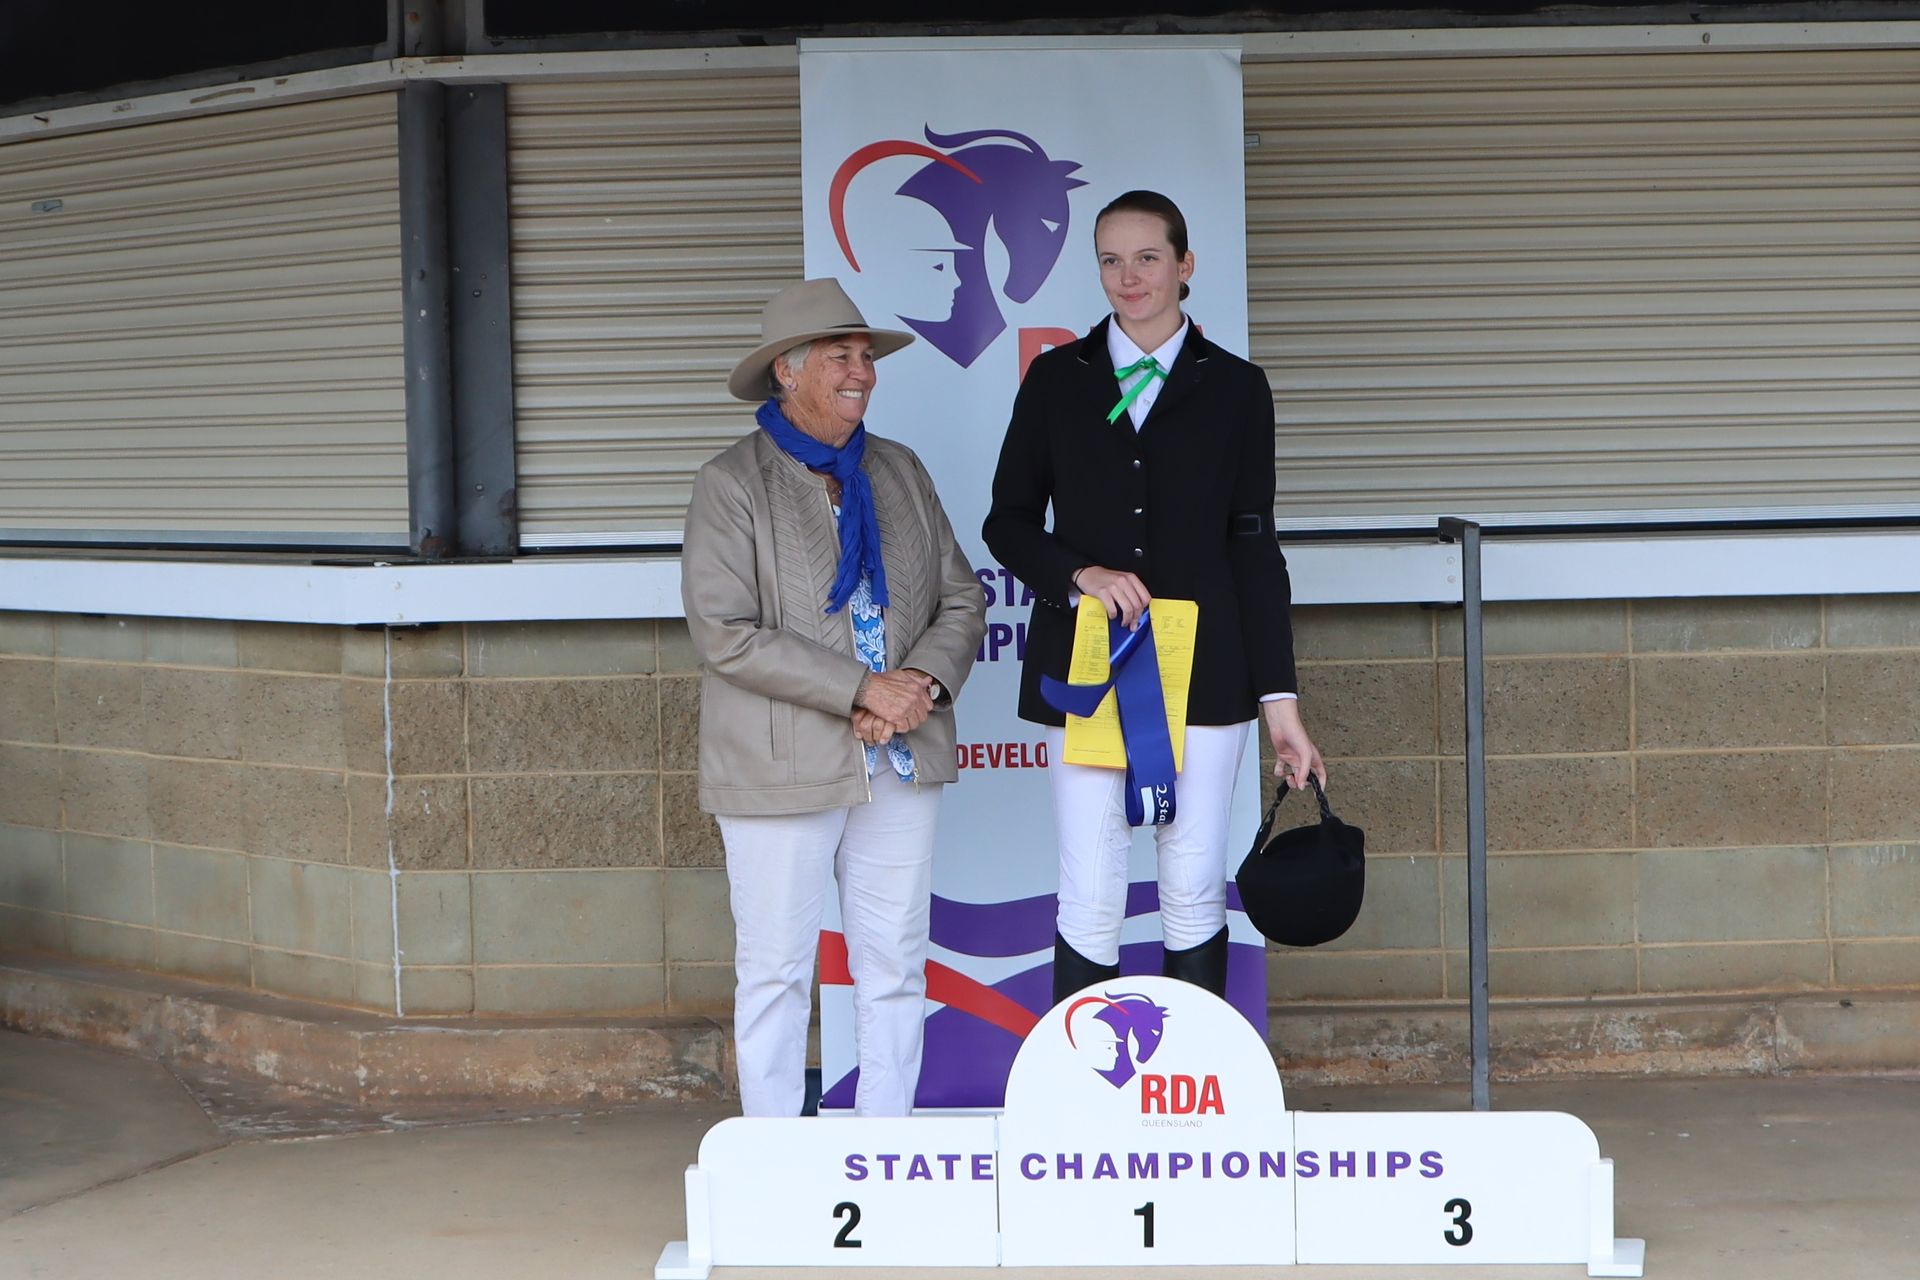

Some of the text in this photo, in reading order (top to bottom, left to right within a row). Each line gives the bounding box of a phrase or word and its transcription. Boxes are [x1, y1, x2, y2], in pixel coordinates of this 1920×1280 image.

[1141, 1074, 1225, 1114] RDA
[1141, 1119, 1203, 1128] QUEENSLAND
[845, 1150, 1444, 1181] STATE CHAMPIONSHIPS
[832, 1201, 863, 1249] 2
[1133, 1201, 1155, 1249] 1
[1443, 1197, 1474, 1247] 3
